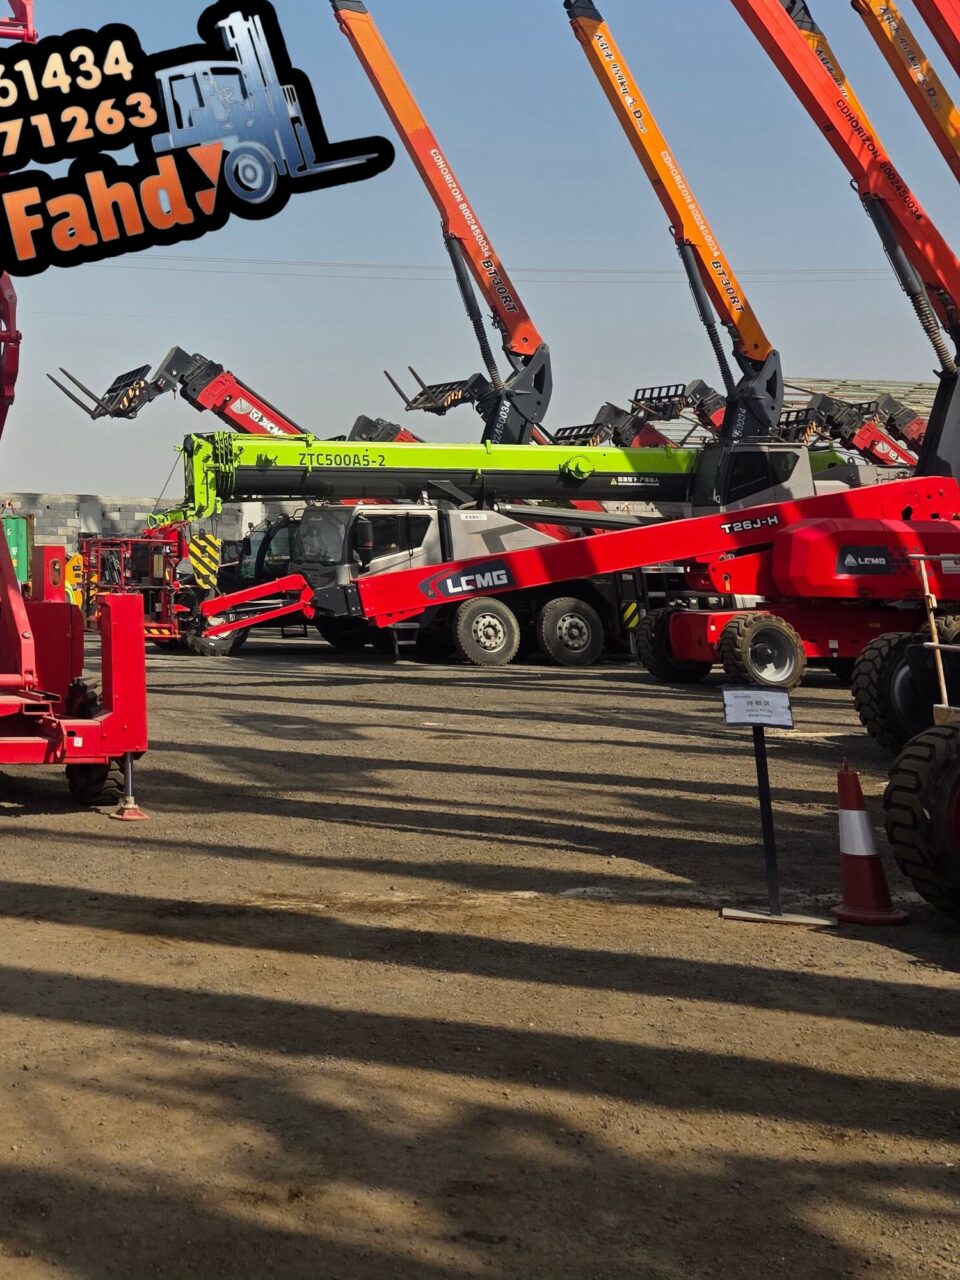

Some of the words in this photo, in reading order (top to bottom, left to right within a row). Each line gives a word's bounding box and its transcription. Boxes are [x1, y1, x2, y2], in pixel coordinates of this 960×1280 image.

[660, 150, 692, 204] CDHORIZON
[835, 99, 880, 160] CDHORIZON
[879, 162, 924, 221] 8002450034
[430, 148, 463, 203] CDHORIZON
[459, 203, 492, 258] 8002450034
[481, 258, 518, 313] BT30RT
[711, 260, 745, 313] BT30RT
[299, 453, 386, 467] ZTC500A5-2
[720, 515, 779, 534] T26J-H
[446, 569, 509, 593] LCMG
